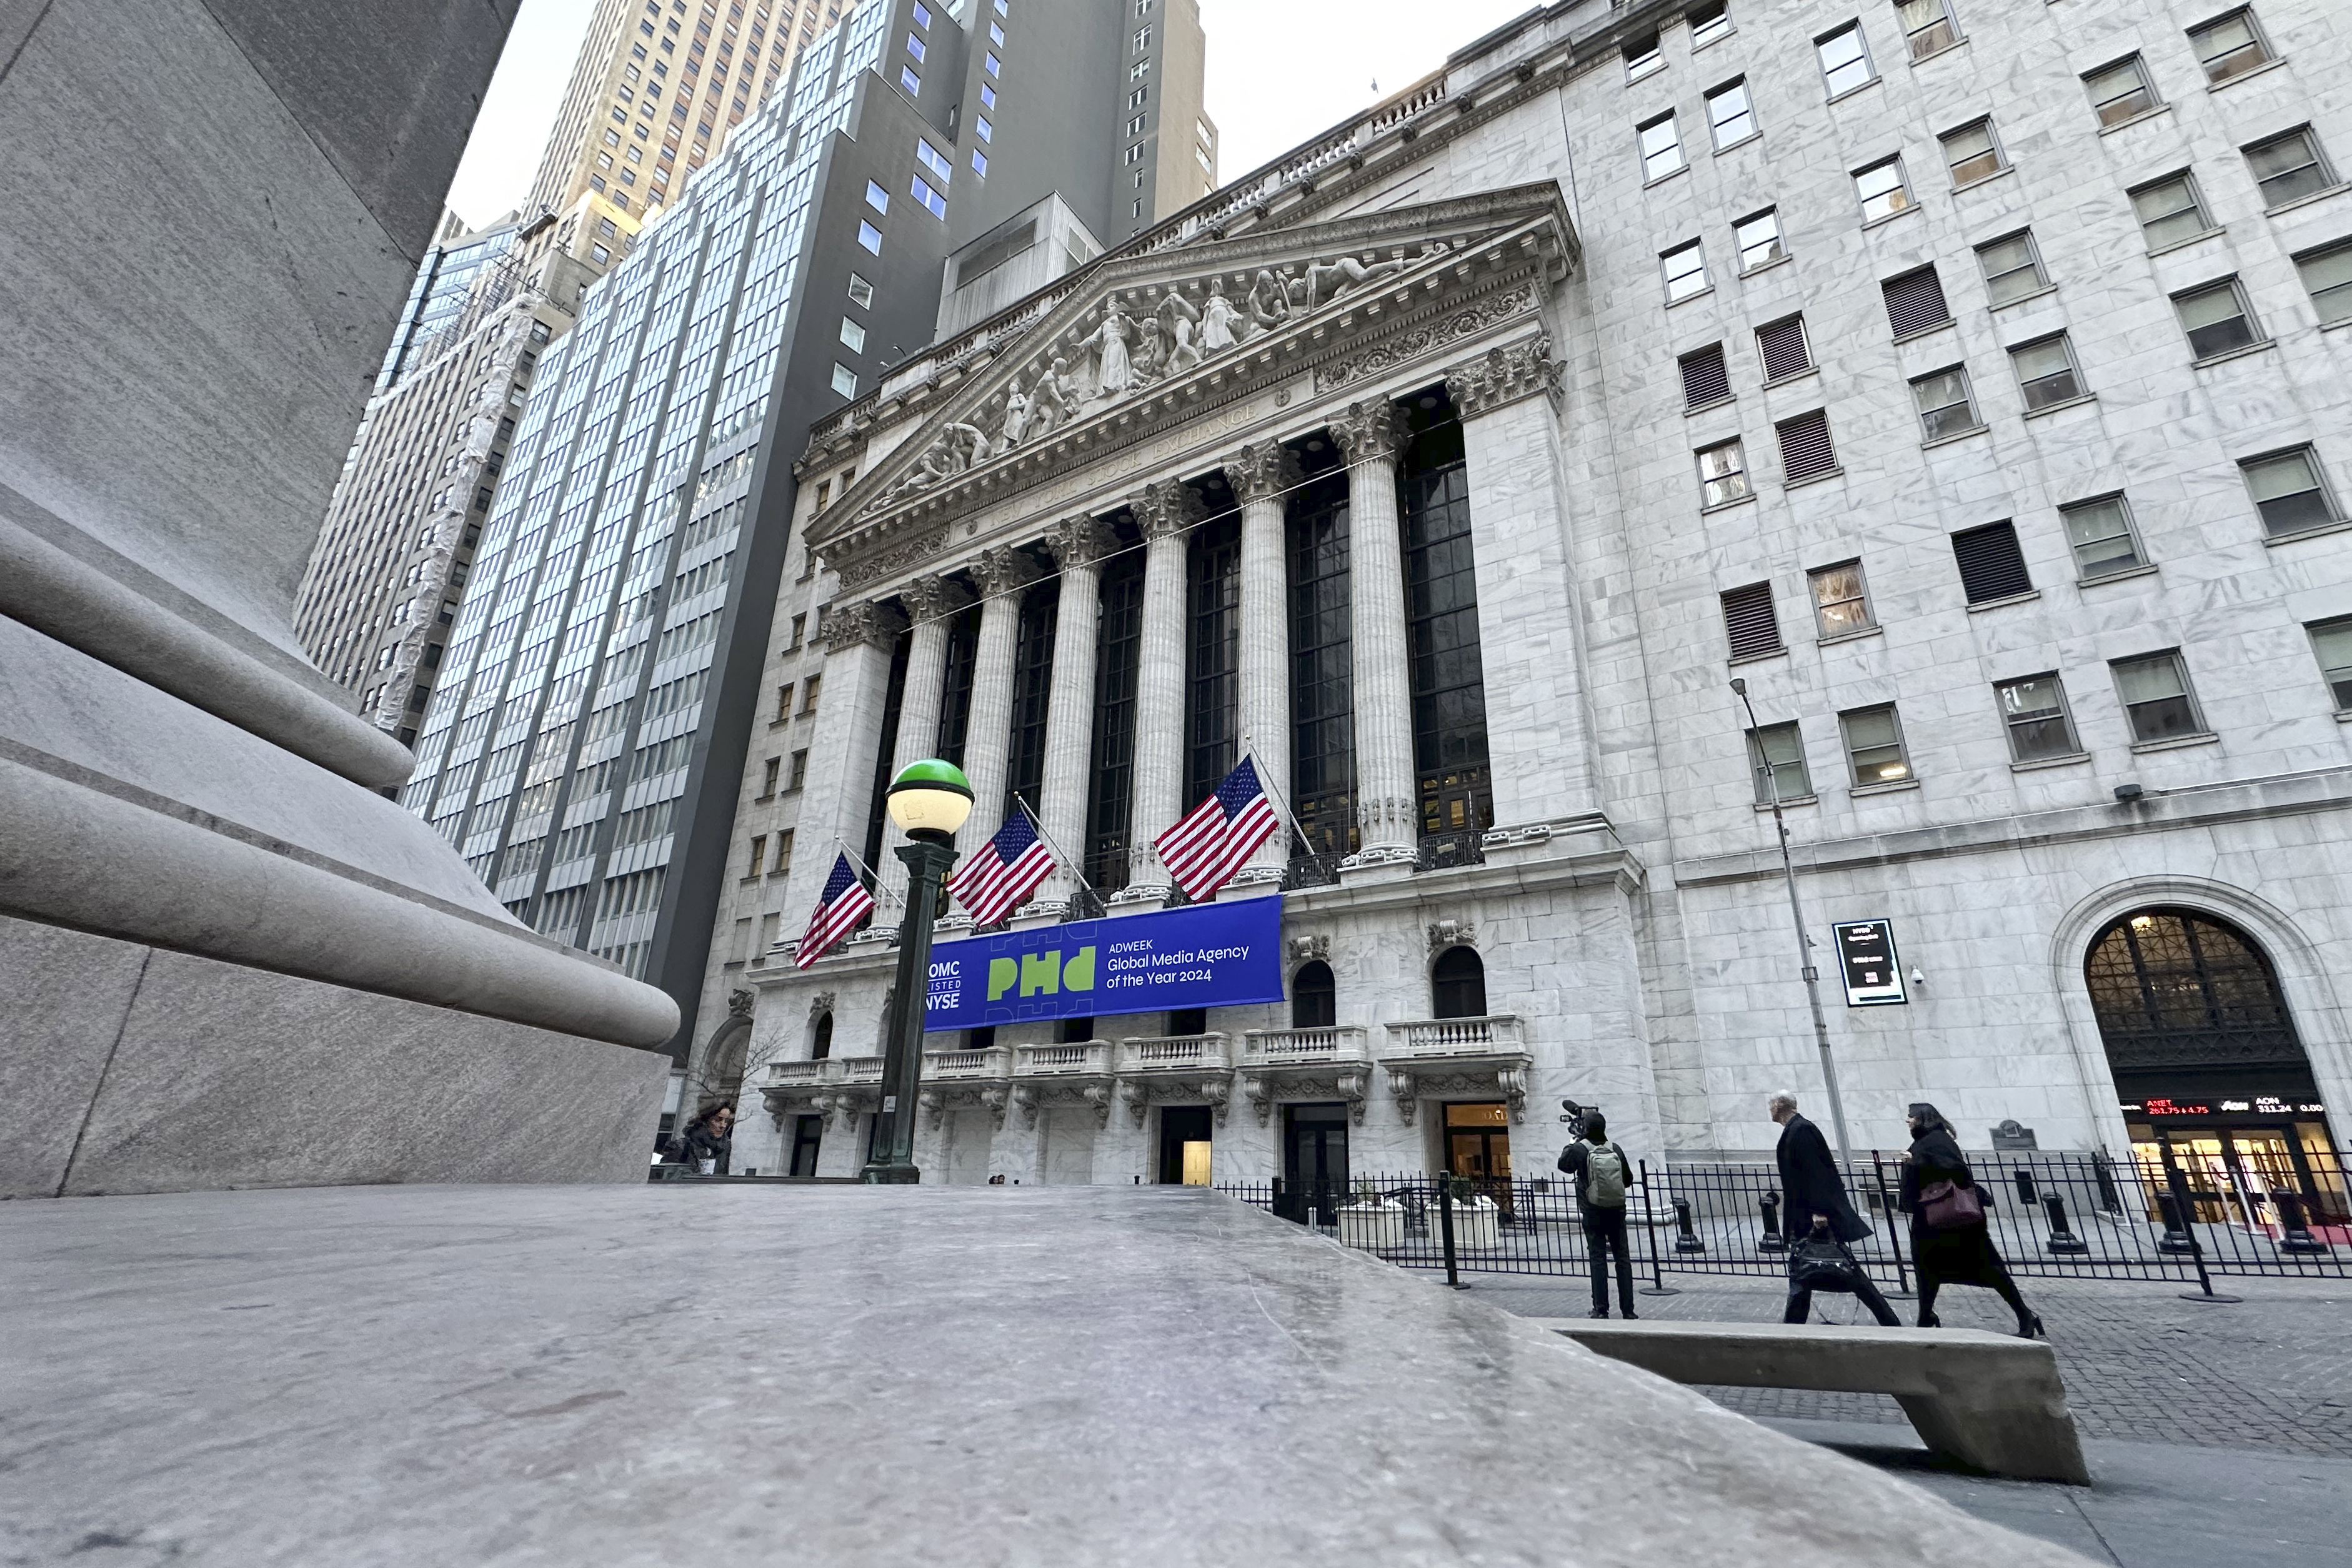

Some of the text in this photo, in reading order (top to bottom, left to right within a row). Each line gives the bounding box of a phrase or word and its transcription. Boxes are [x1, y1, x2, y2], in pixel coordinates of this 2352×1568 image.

[990, 405, 1256, 526] NEW YORK STOCK EXCHANGE
[1109, 939, 1153, 954] ADWEEK
[1108, 946, 1249, 971] Global Media Agency
[929, 960, 960, 978] OMC
[927, 980, 961, 992] ISTED
[1107, 968, 1212, 989] of the Year 2024
[2256, 1097, 2280, 1105] AON
[2300, 1104, 2324, 1112] 0.00
